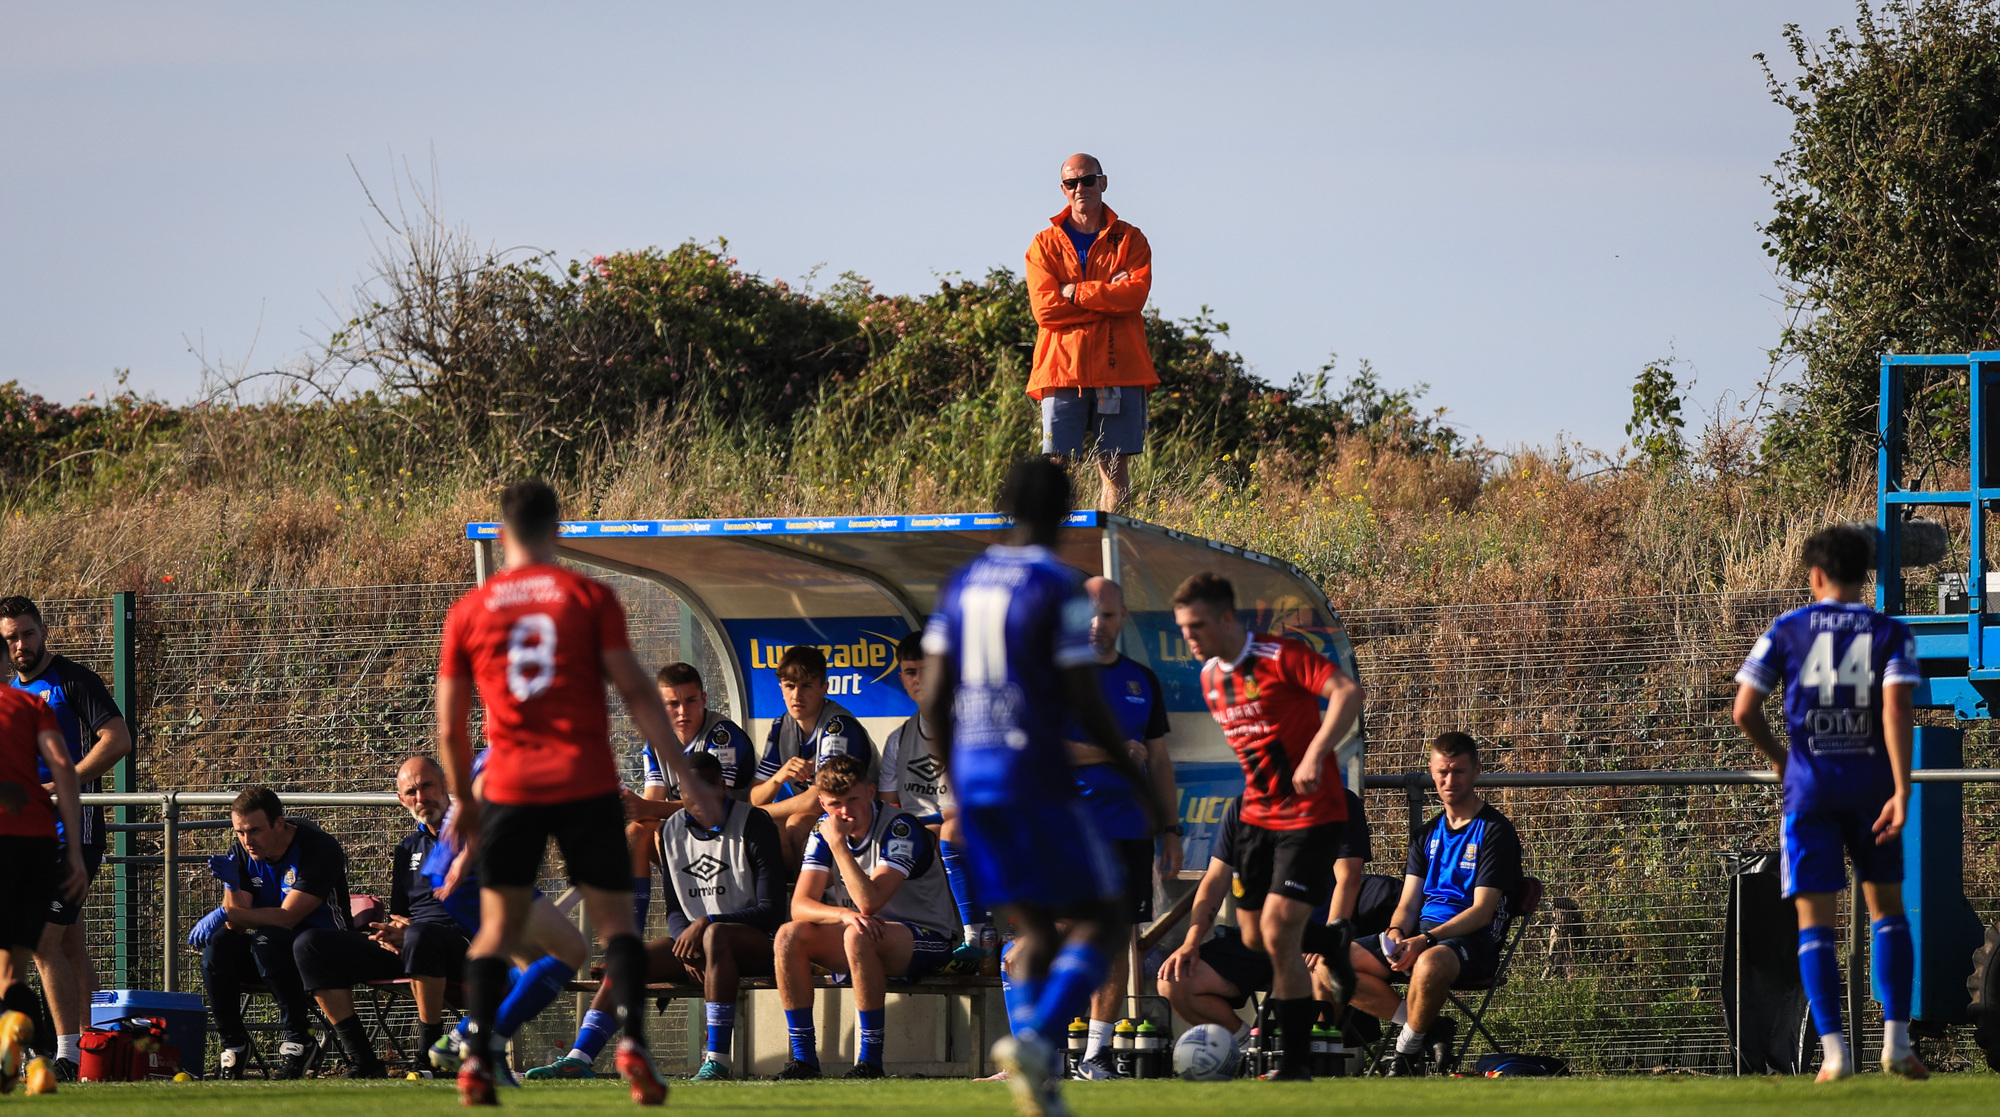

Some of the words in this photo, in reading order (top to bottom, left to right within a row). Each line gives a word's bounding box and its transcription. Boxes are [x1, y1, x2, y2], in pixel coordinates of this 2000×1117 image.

[960, 583, 1012, 687] 11
[506, 612, 557, 702] 8
[750, 637, 886, 669] Luzade
[826, 673, 863, 695] ort
[1800, 631, 1875, 708] 44
[903, 783, 948, 796] umbro
[688, 885, 726, 898] umbro
